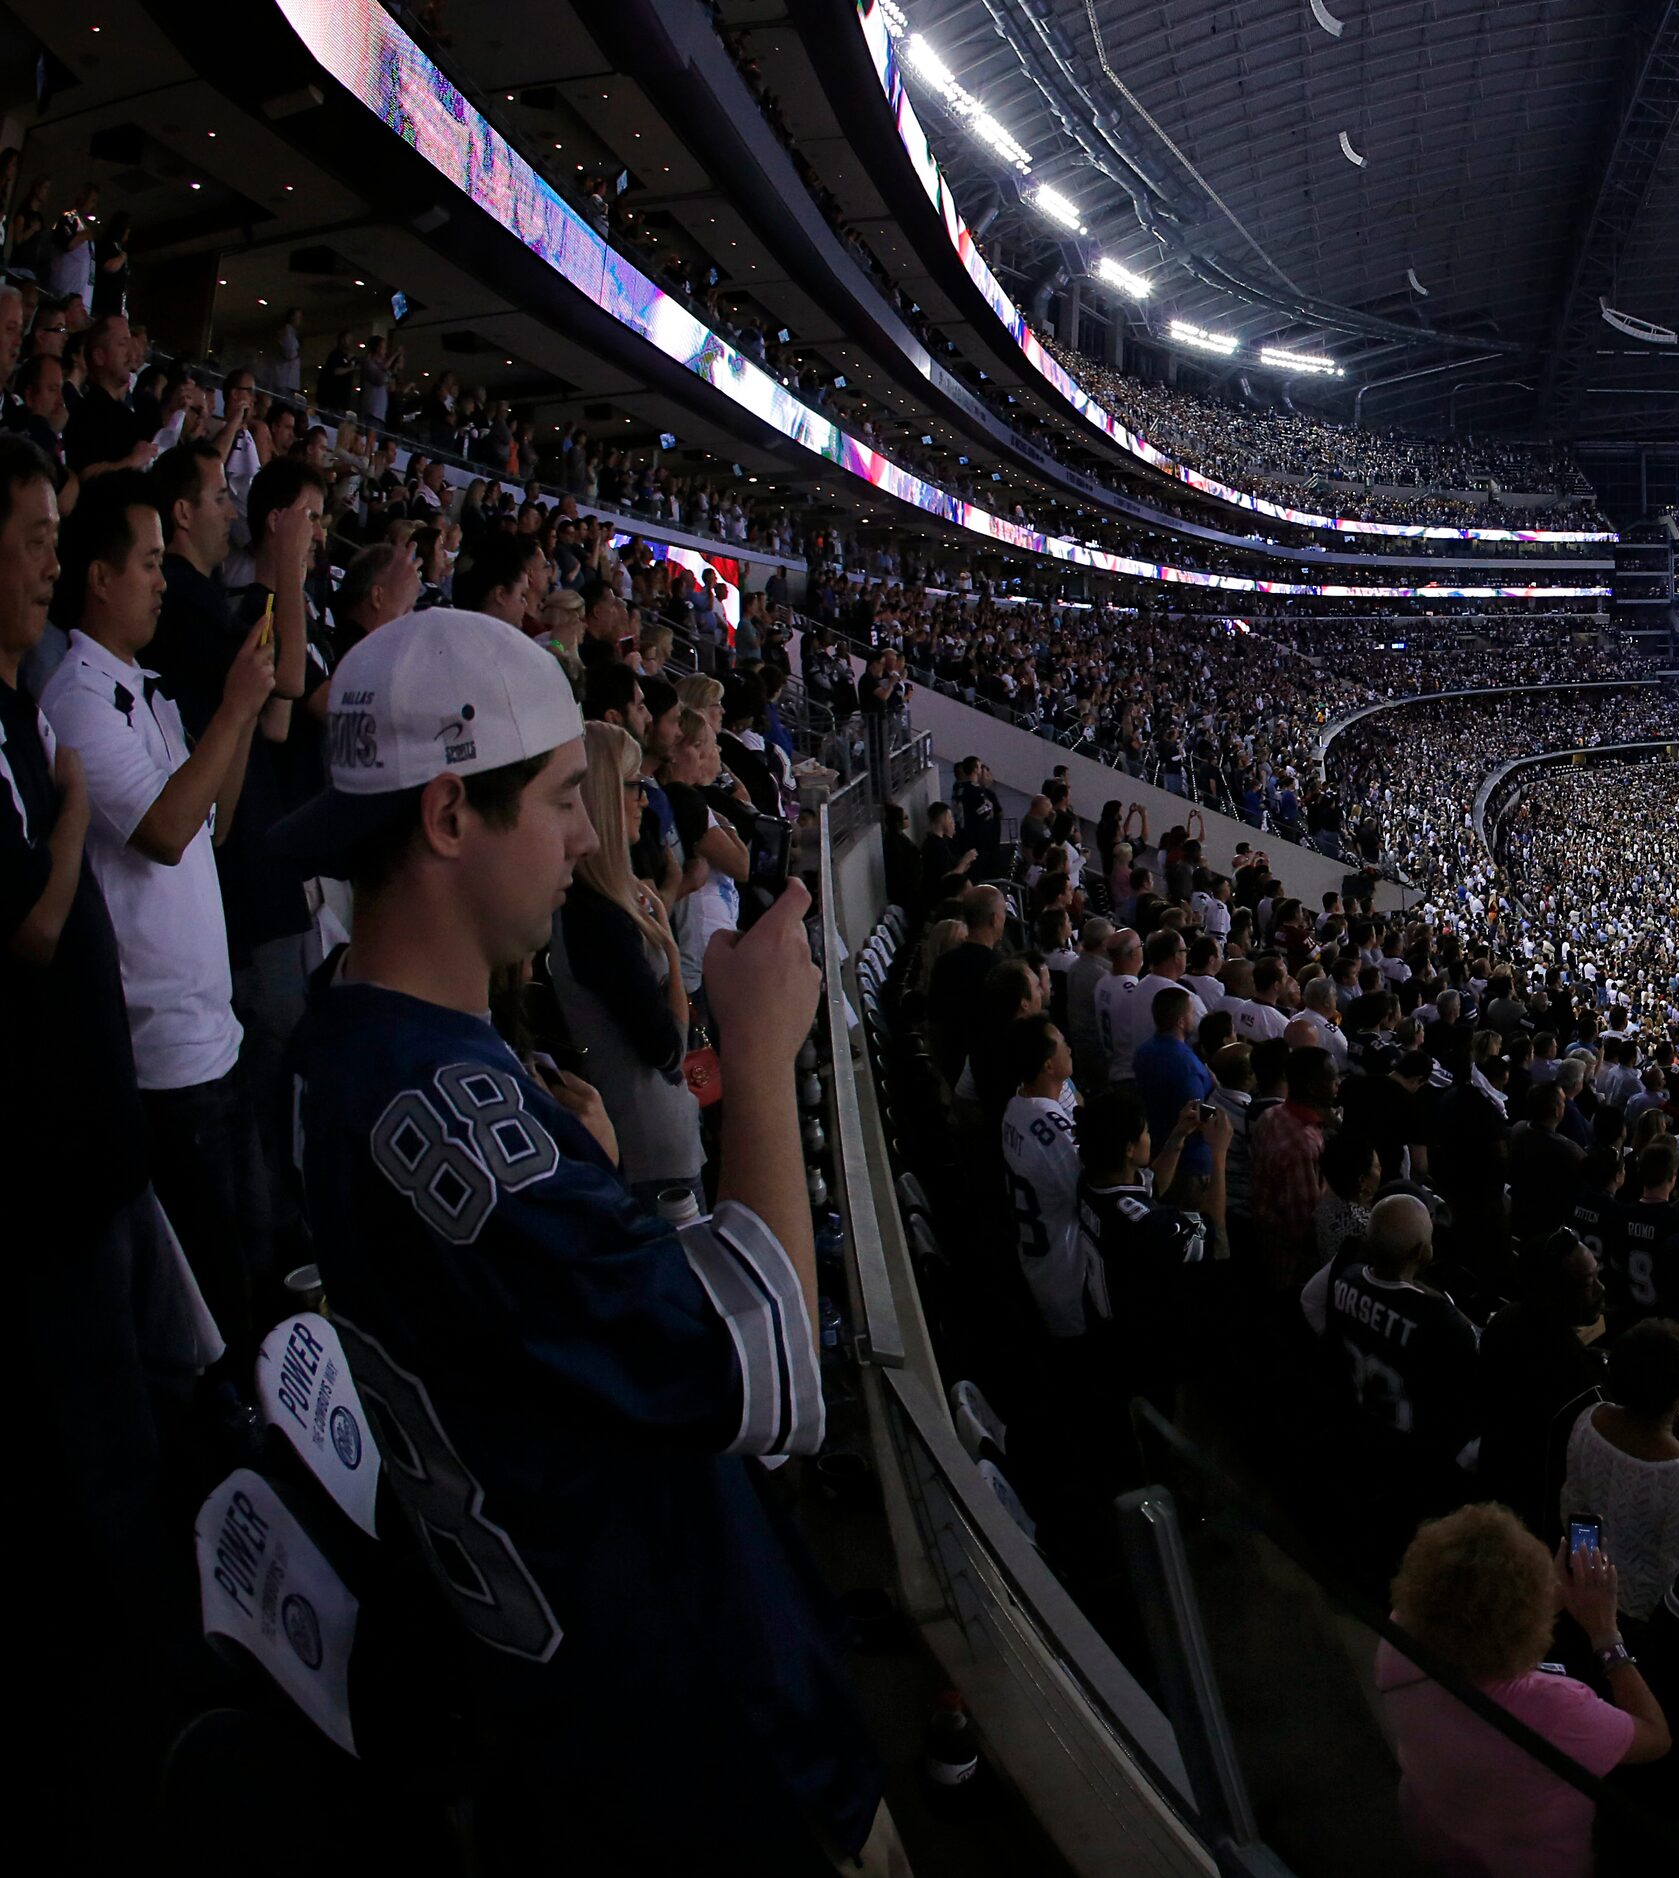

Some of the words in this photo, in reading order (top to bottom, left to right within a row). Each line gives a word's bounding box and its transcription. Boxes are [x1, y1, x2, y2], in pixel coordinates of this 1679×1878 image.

[370, 1062, 560, 1246] 88
[1031, 1112, 1073, 1146] 88
[1627, 1221, 1656, 1241] ROMO
[1628, 1249, 1658, 1305] 9
[279, 1322, 323, 1430] POWER
[215, 1490, 269, 1619] POWER
